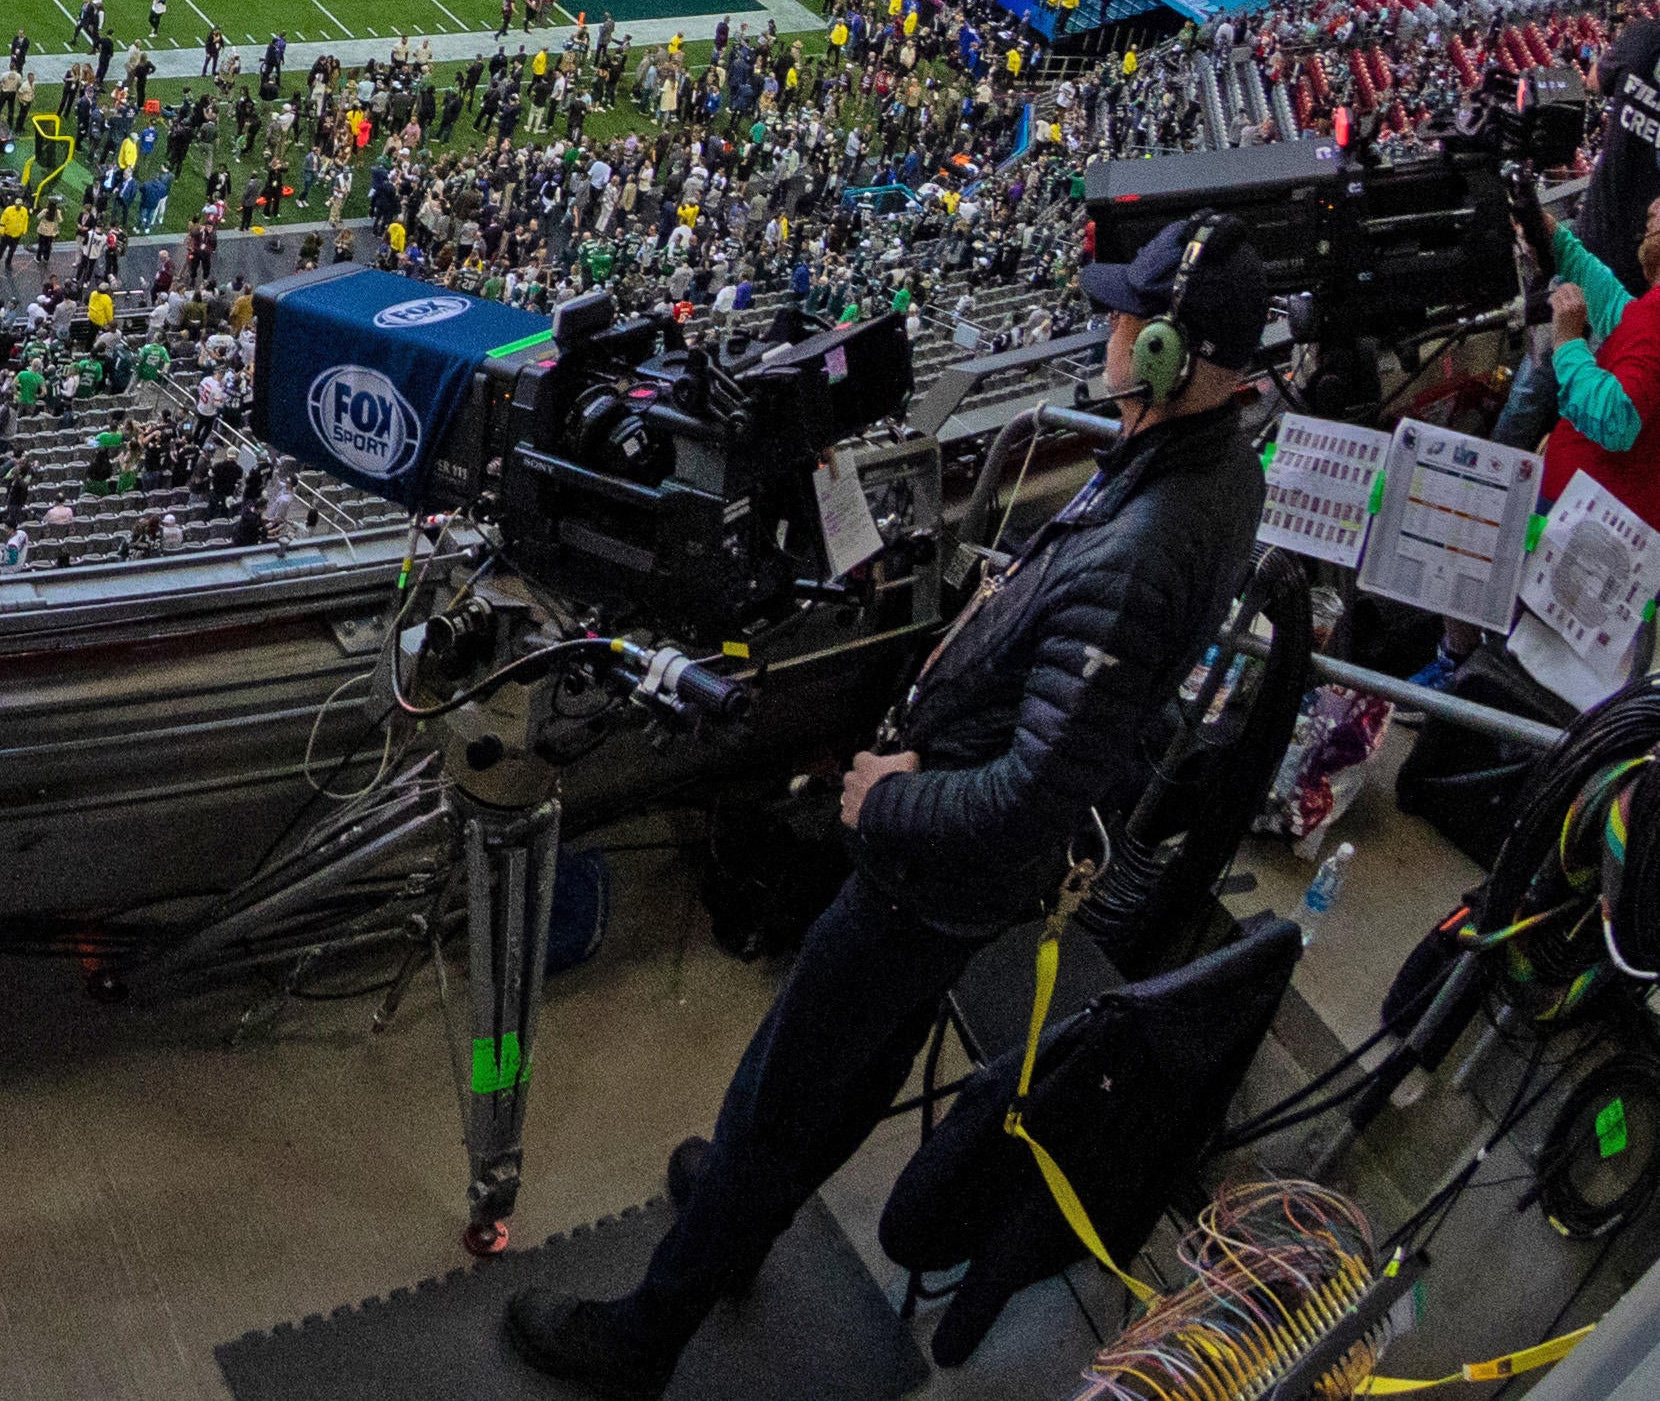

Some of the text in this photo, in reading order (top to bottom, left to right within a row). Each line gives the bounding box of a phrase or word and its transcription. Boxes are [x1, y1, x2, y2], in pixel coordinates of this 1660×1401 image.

[1624, 73, 1660, 111] FIL
[1621, 104, 1660, 149] CRE
[390, 301, 446, 320] FOX
[335, 382, 393, 438] FOX
